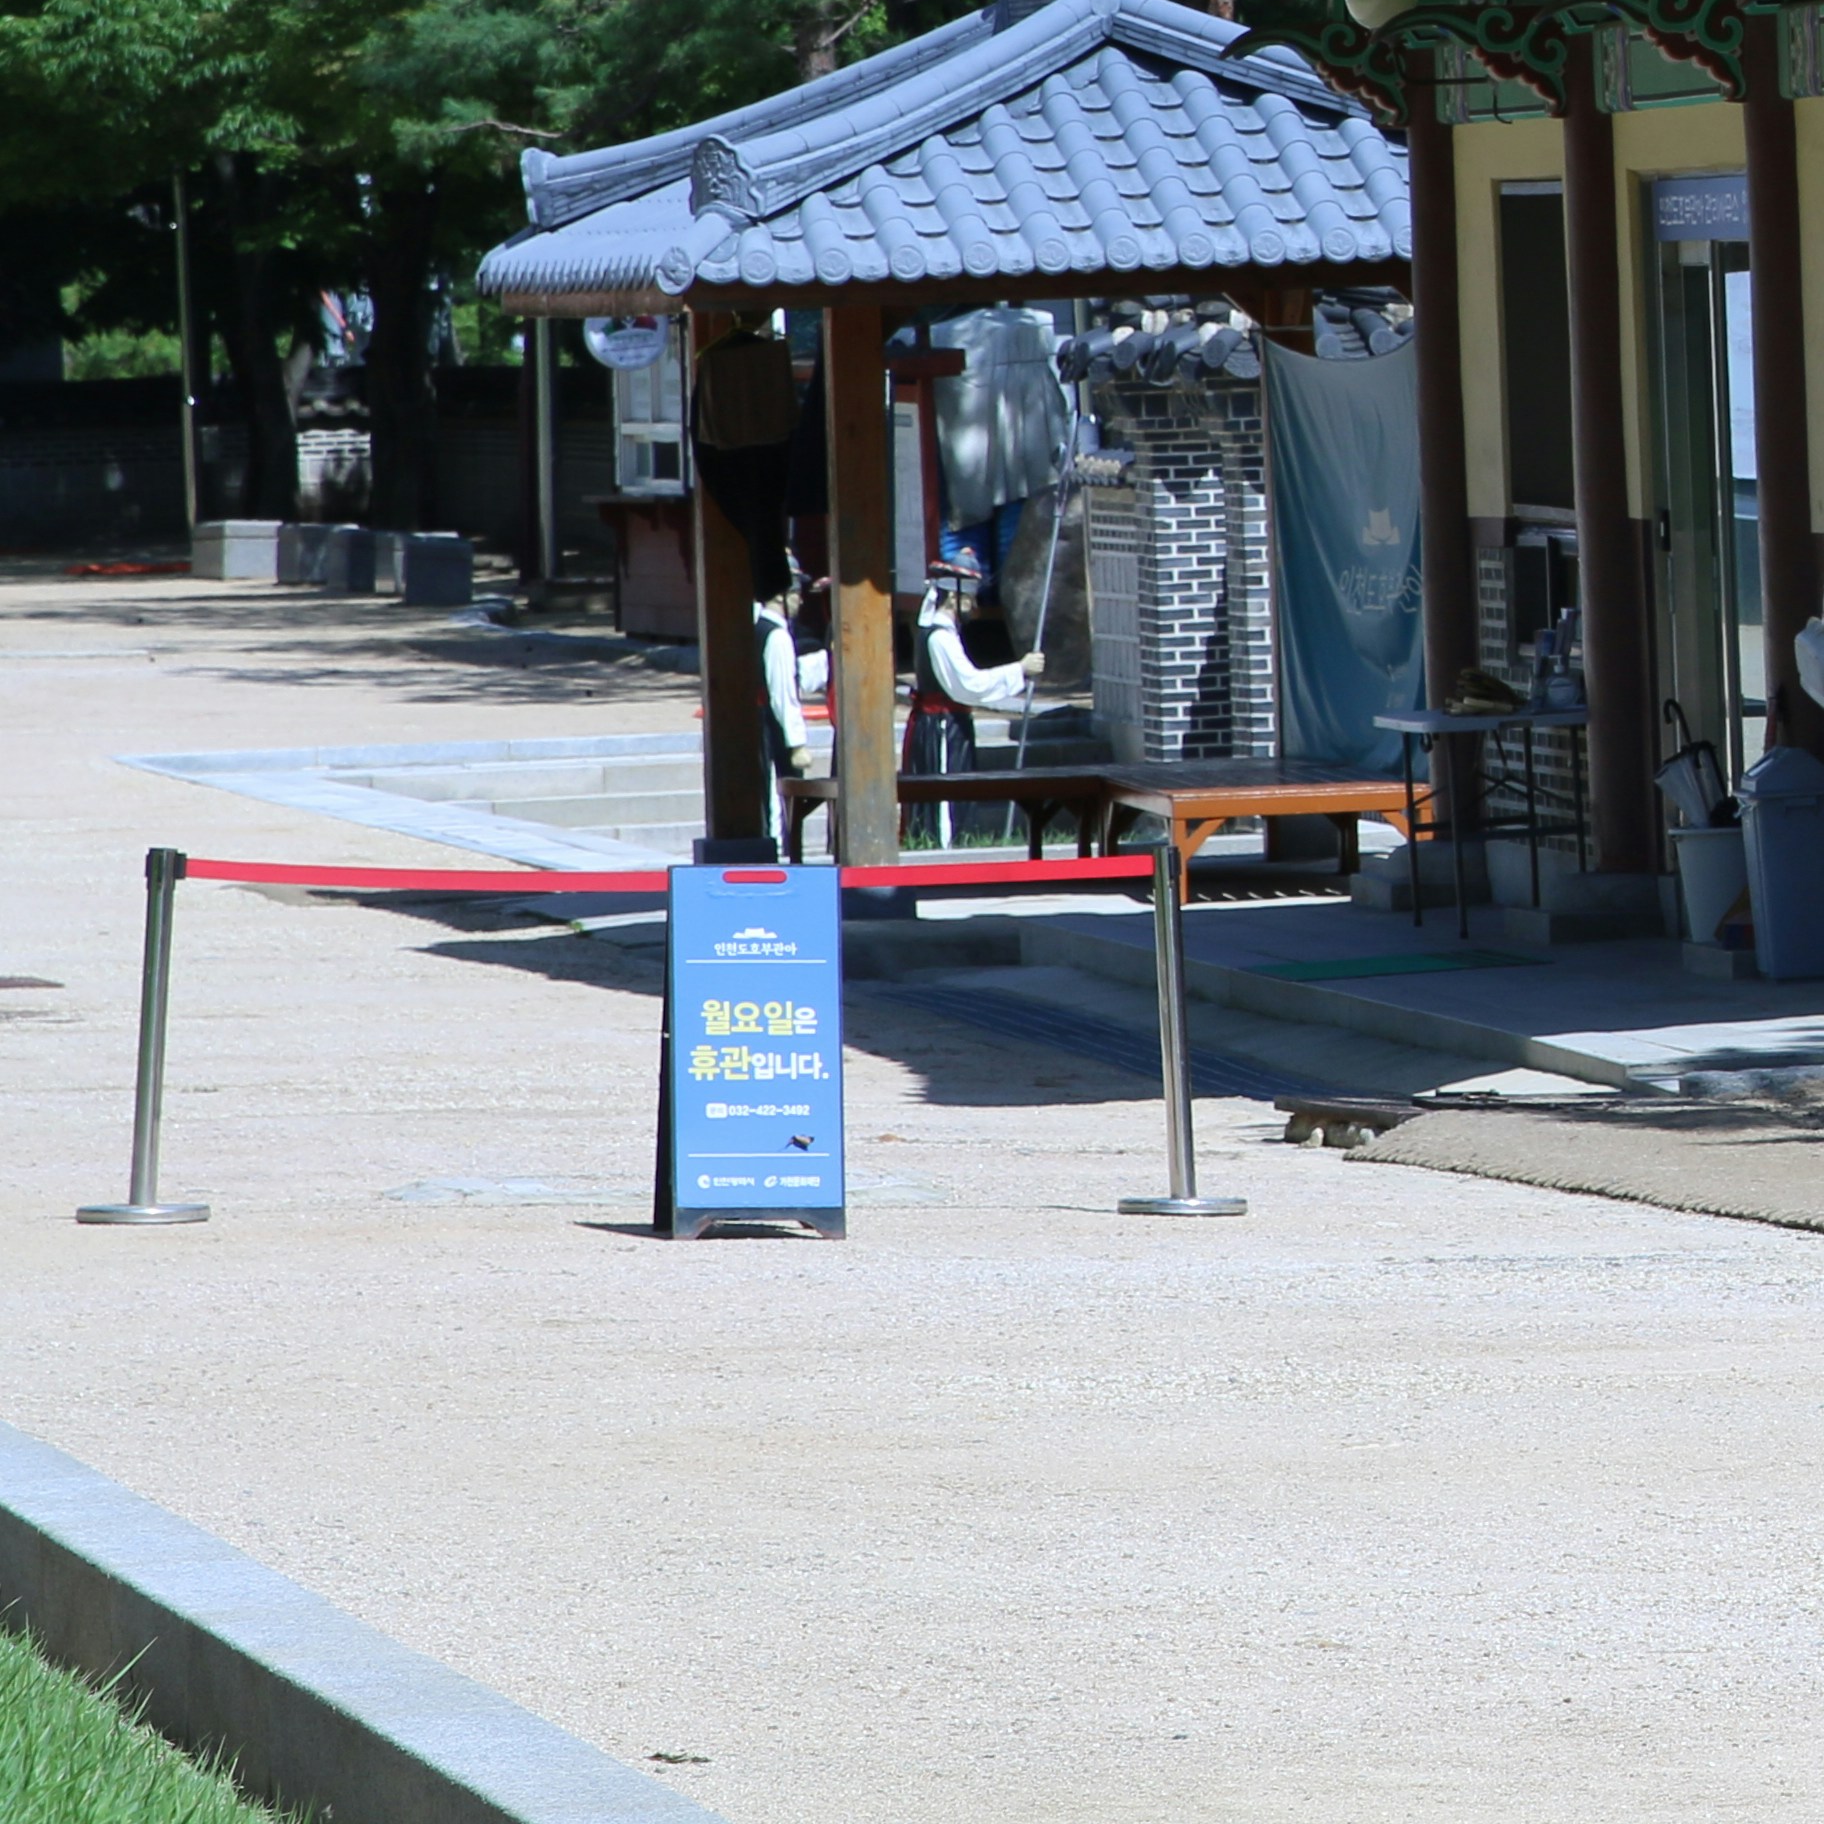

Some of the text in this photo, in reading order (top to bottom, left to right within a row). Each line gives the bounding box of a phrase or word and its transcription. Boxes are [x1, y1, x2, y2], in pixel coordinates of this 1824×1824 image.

[713, 941, 797, 956] 인천도호부관아
[700, 999, 818, 1036] 월요일은
[688, 1045, 830, 1081] 휴관입니다.
[728, 1104, 811, 1116] 032-422-3492
